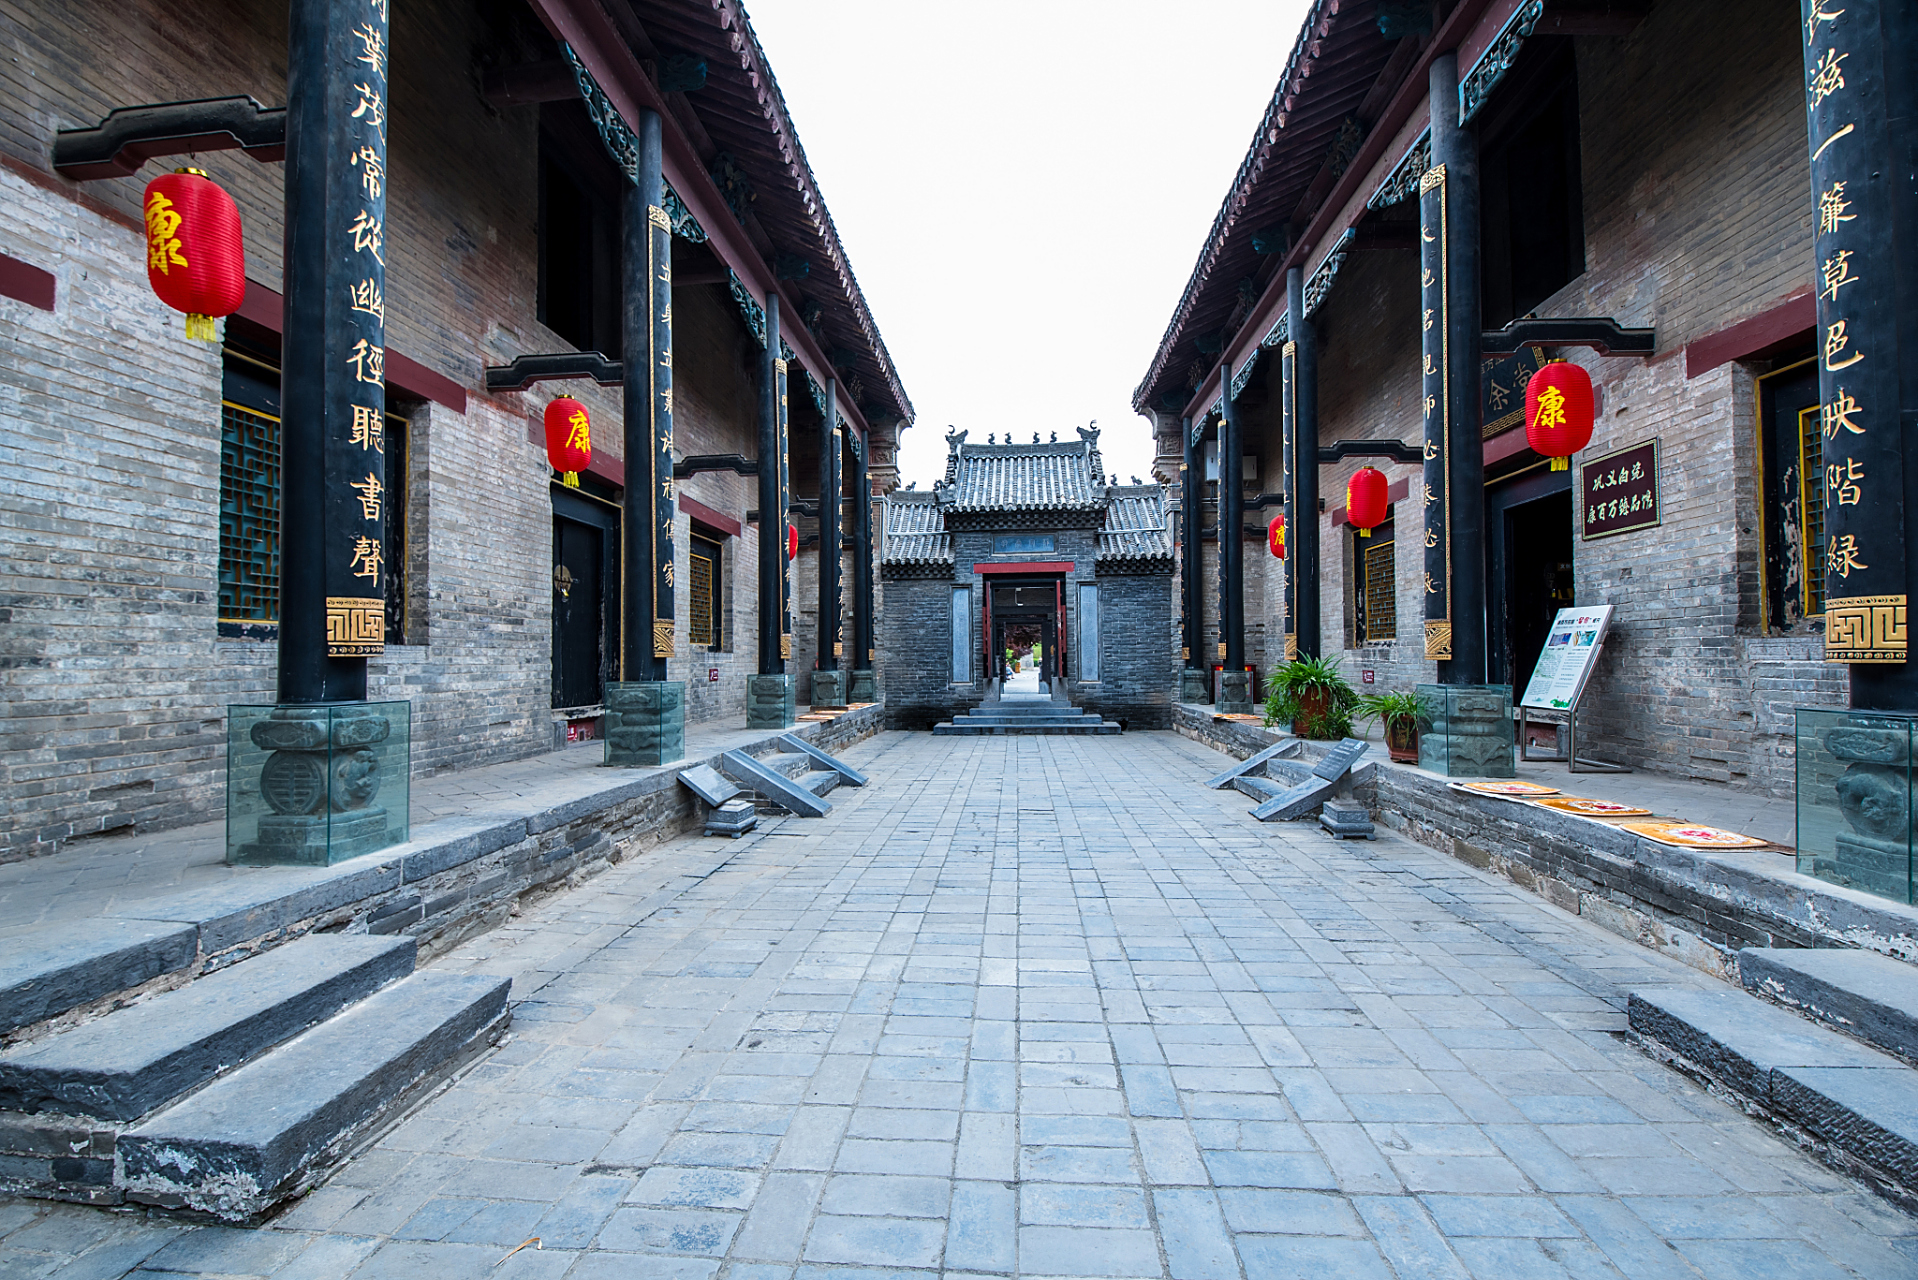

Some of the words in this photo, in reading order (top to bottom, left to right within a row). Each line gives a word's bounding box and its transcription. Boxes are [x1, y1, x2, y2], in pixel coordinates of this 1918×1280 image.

[145, 192, 188, 275] 康
[347, 0, 386, 587] 葉茂常從幽徑聽書聲
[565, 410, 590, 453] 康
[1533, 386, 1566, 428] 康
